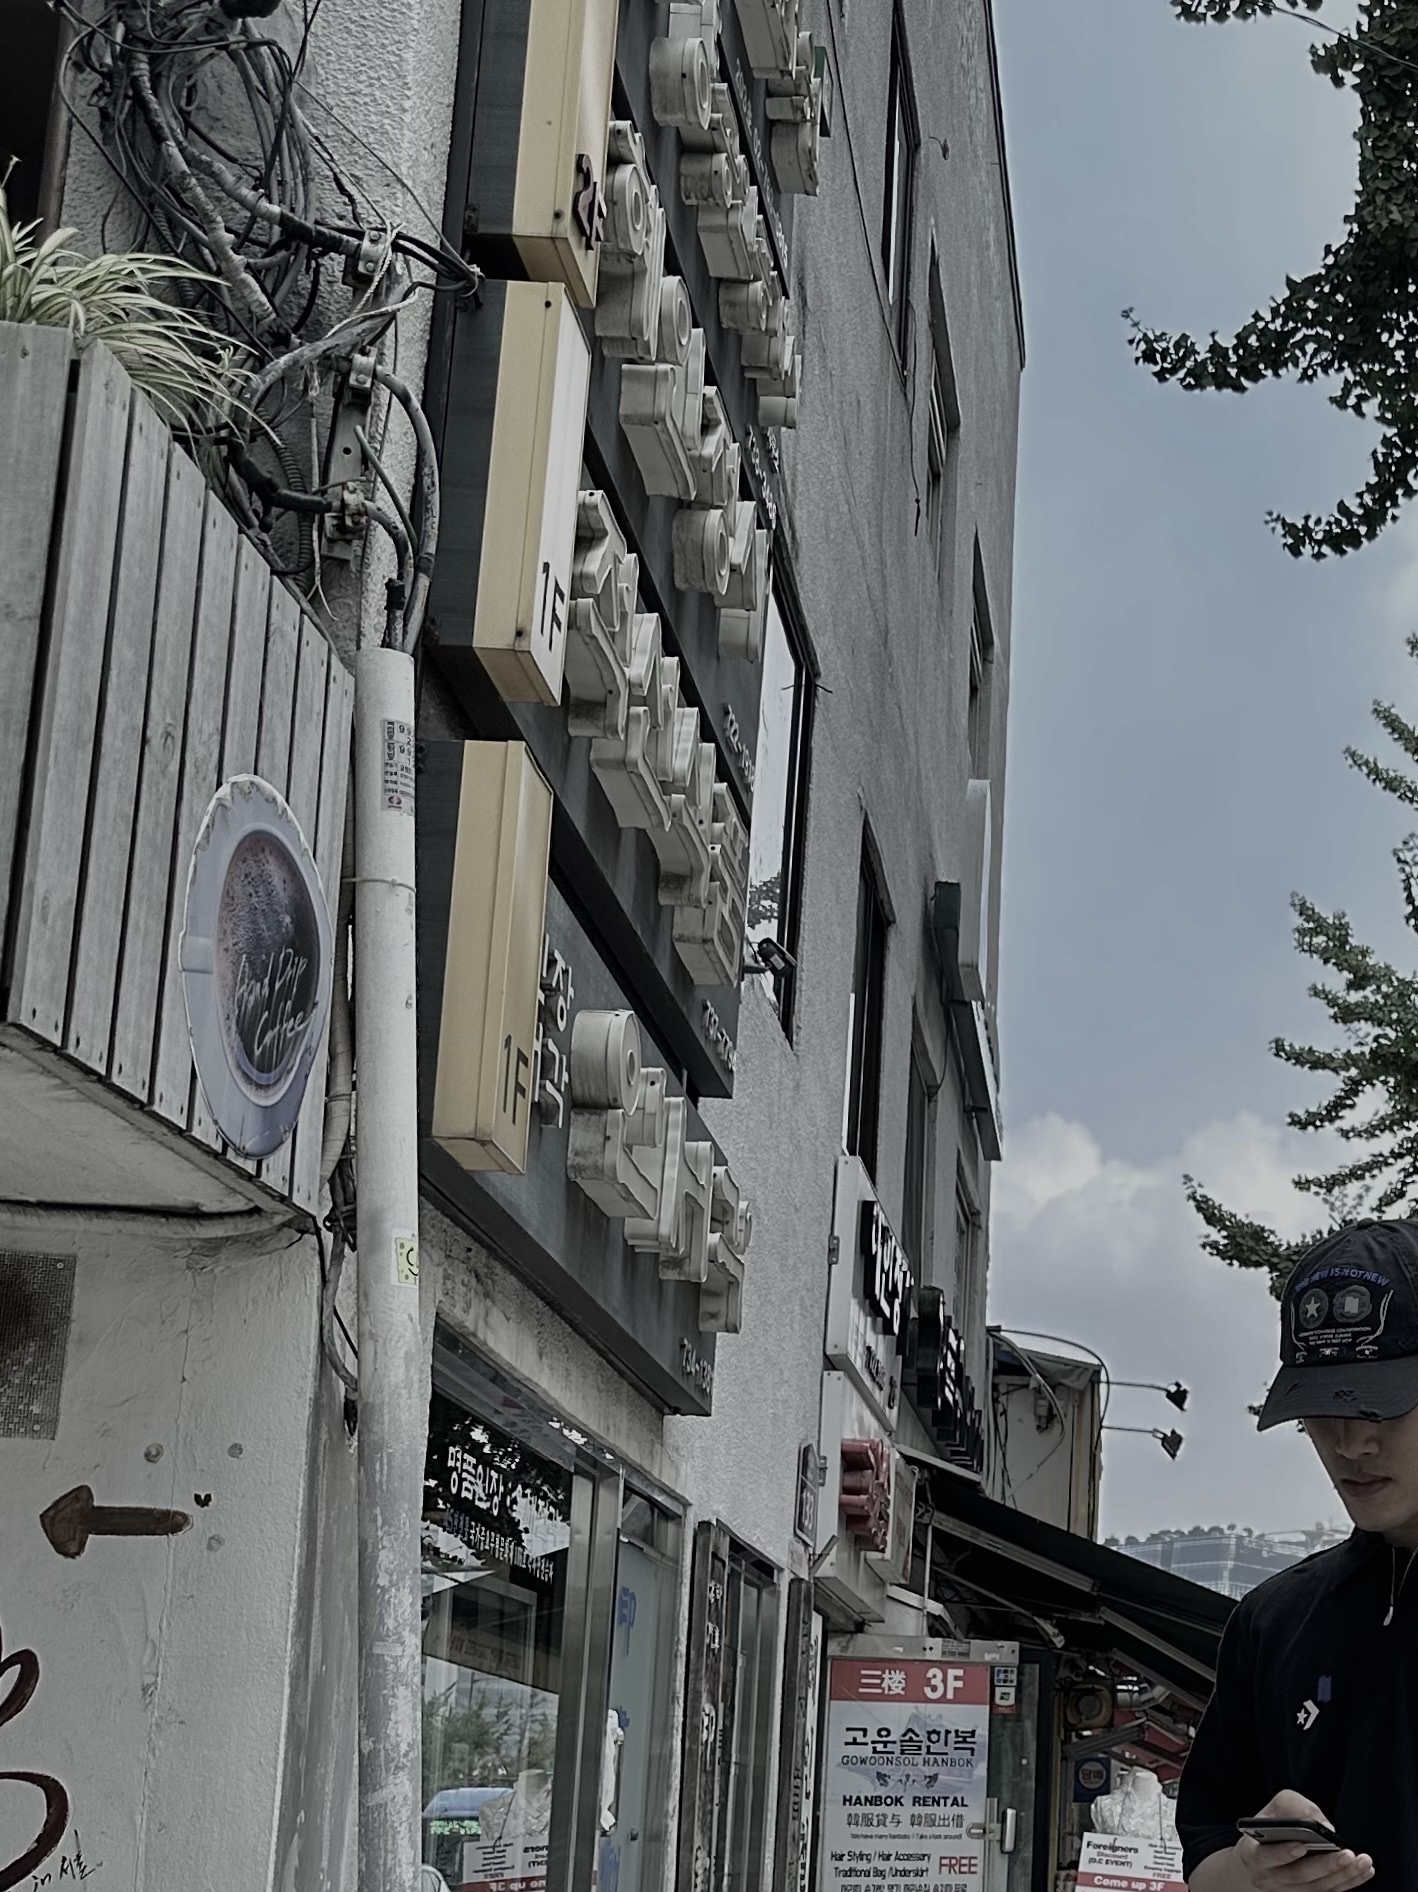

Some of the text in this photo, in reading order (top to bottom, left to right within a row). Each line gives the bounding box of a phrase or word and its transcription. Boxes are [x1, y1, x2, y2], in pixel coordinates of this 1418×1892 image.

[541, 561, 566, 652] 1F
[254, 1000, 312, 1058] Coffee
[503, 1035, 530, 1125] 1F
[1329, 1268, 1340, 1277] IS
[1341, 1268, 1362, 1279] NOT
[1363, 1272, 1390, 1287] NEW
[858, 1667, 964, 1699] 三楼 3F
[844, 1727, 977, 1757] 고운솔한복
[841, 1755, 974, 1768] GOWOONSOL HANBOK
[842, 1794, 969, 1808] HANBOK RENTAL
[1086, 1841, 1139, 1854] Foreigners
[831, 1851, 846, 1862] Hair
[847, 1851, 872, 1864] Styling
[878, 1851, 893, 1862] Hair
[939, 1856, 978, 1875] FREE
[1105, 1859, 1133, 1869] EVENT)
[872, 1868, 886, 1880] Bag
[1093, 1875, 1165, 1892] Come up 3F
